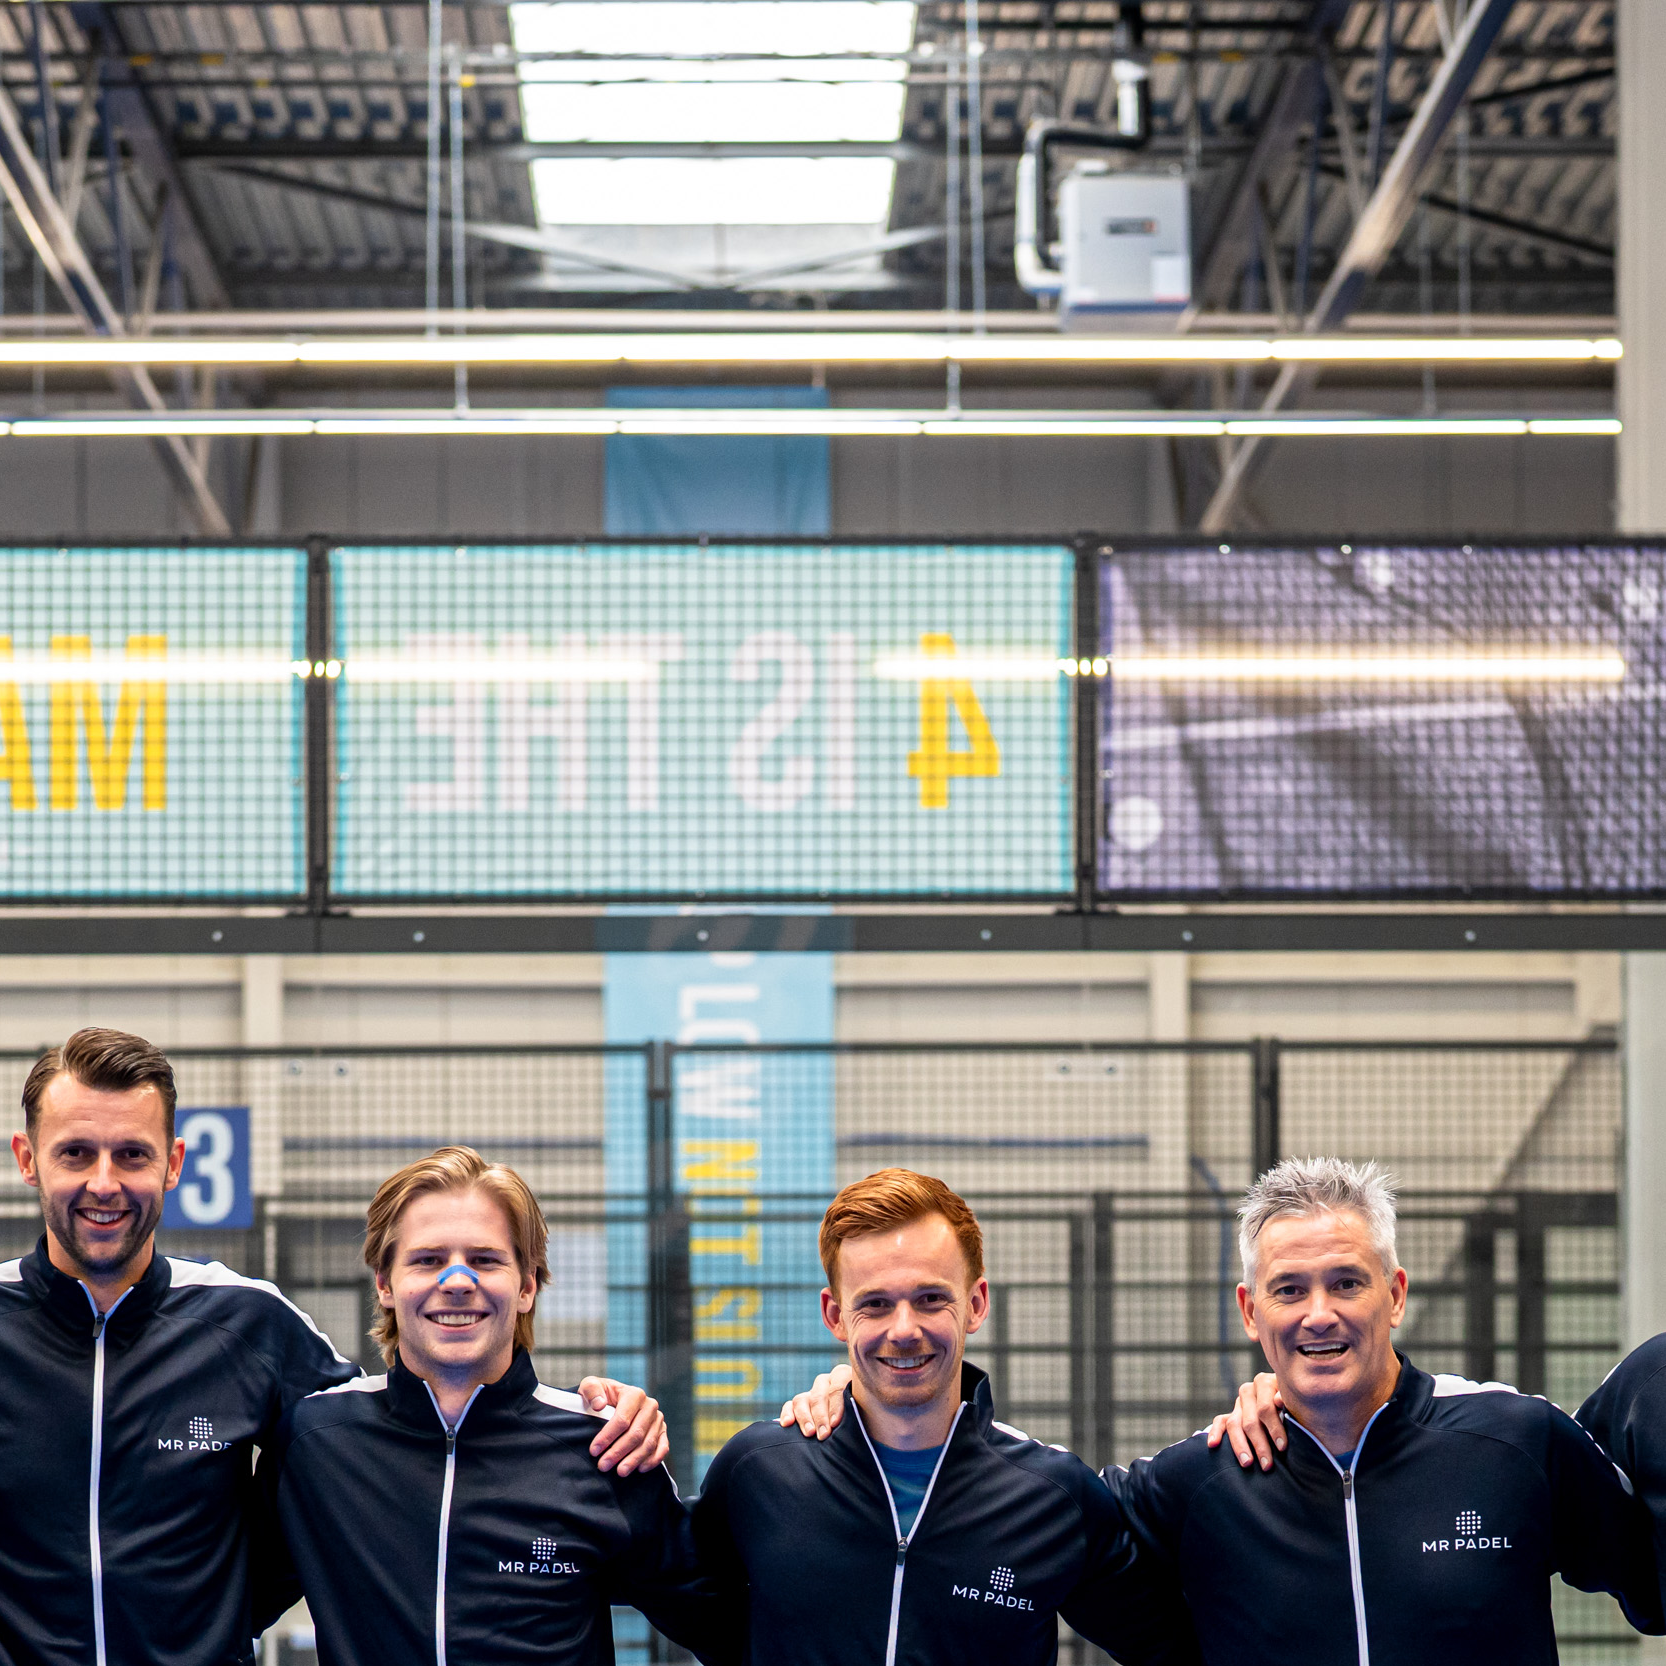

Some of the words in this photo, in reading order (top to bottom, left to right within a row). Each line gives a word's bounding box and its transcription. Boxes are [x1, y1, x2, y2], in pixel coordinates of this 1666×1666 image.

[179, 1112, 234, 1225] 3
[157, 1438, 184, 1451] MR
[188, 1438, 232, 1452] PADE
[1422, 1539, 1450, 1553] MR
[1455, 1536, 1513, 1550] PADEL
[498, 1560, 525, 1573] MR
[529, 1561, 580, 1574] PADEL
[951, 1584, 980, 1601] MR
[984, 1590, 1035, 1611] PADEL
